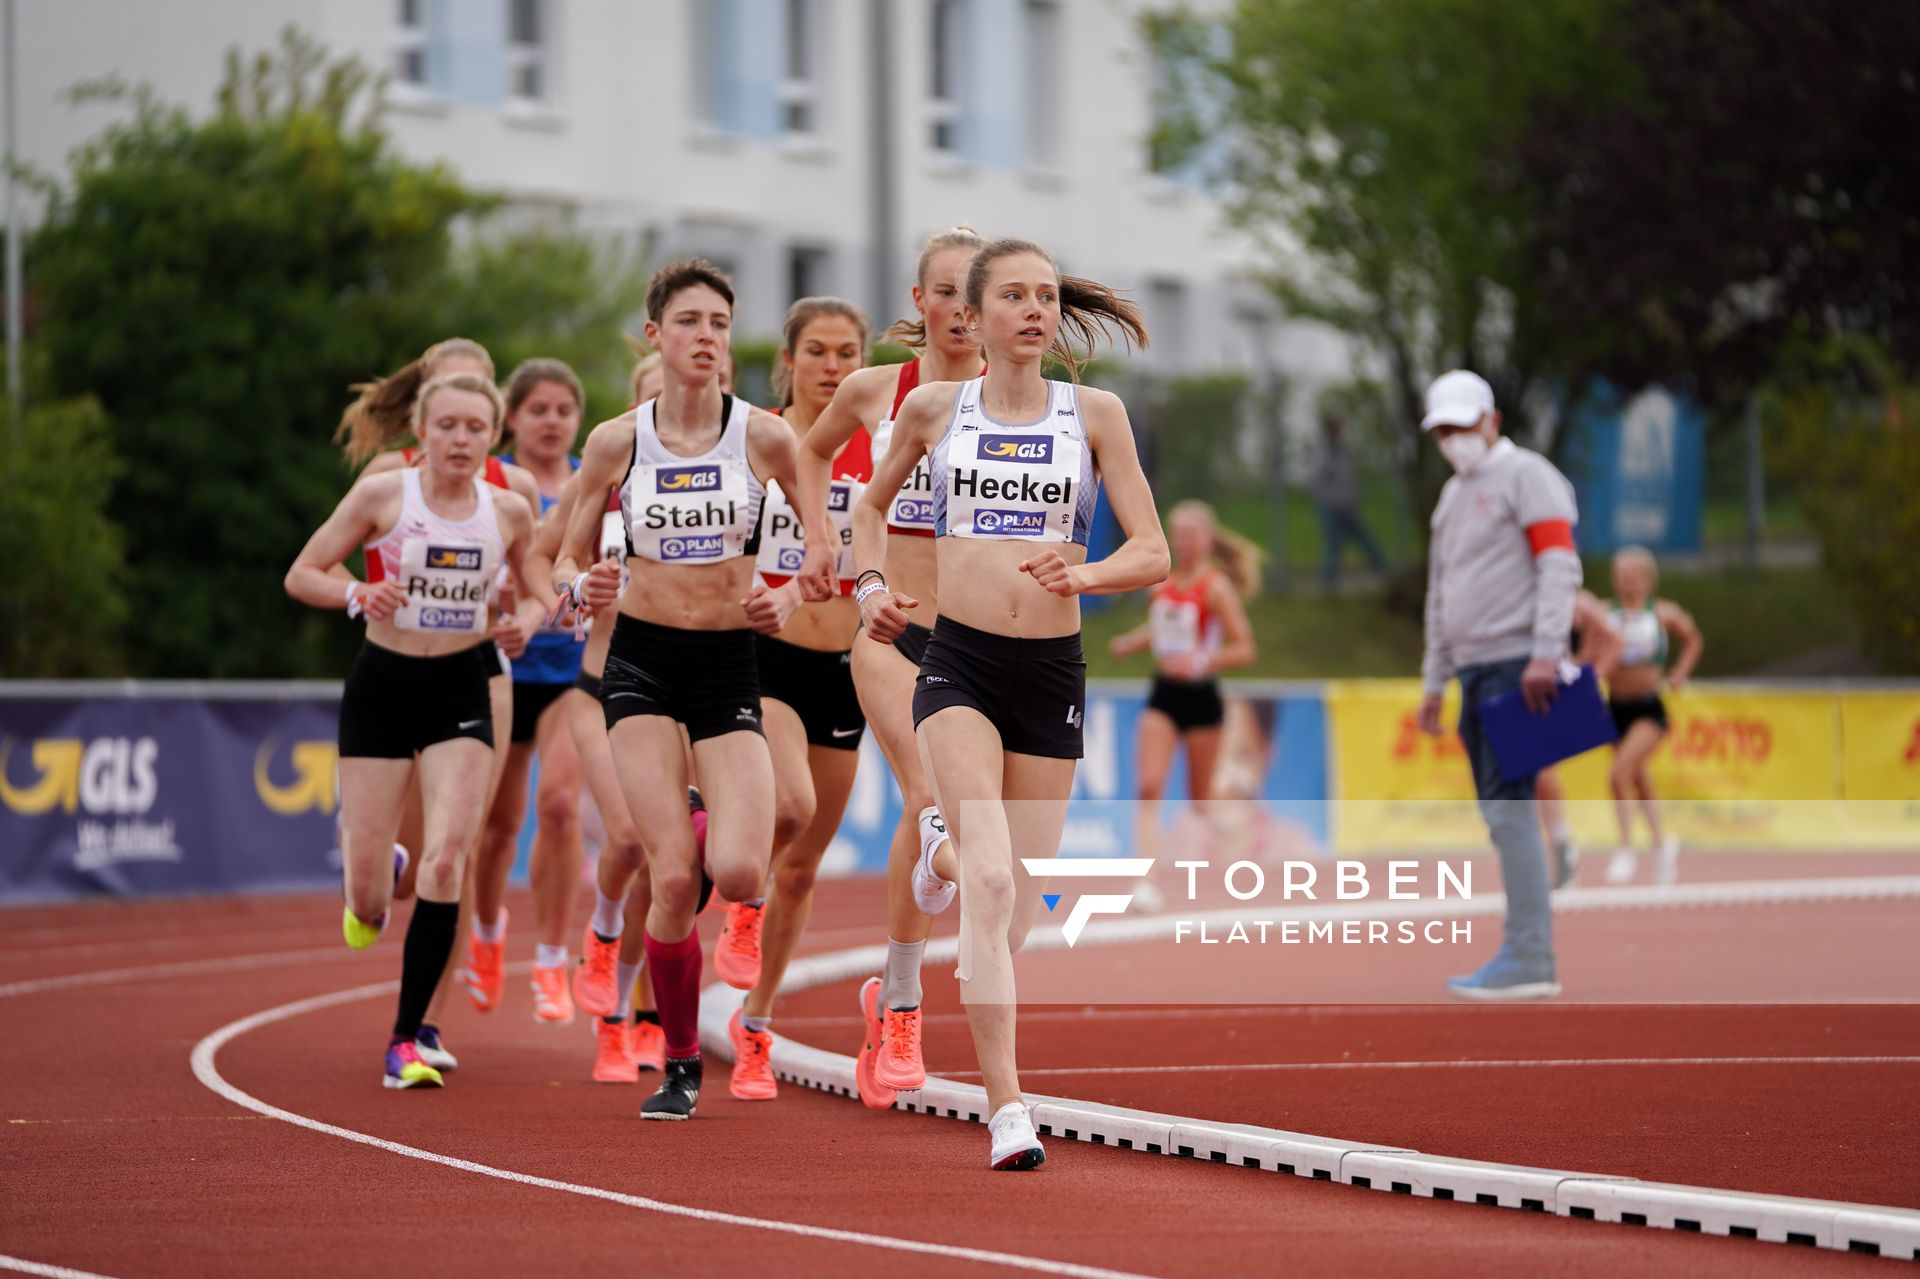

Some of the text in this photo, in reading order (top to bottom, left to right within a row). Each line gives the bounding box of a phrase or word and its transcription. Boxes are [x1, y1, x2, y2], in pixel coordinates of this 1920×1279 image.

[1017, 443, 1046, 458] GLS
[691, 472, 717, 488] GLS
[954, 468, 1071, 504] Heckel
[645, 500, 735, 530] Stahl
[1003, 514, 1042, 527] PLAN
[687, 538, 721, 550] PLAN
[457, 551, 479, 568] GLS
[408, 576, 489, 602] Rödel
[81, 737, 158, 814] GLS
